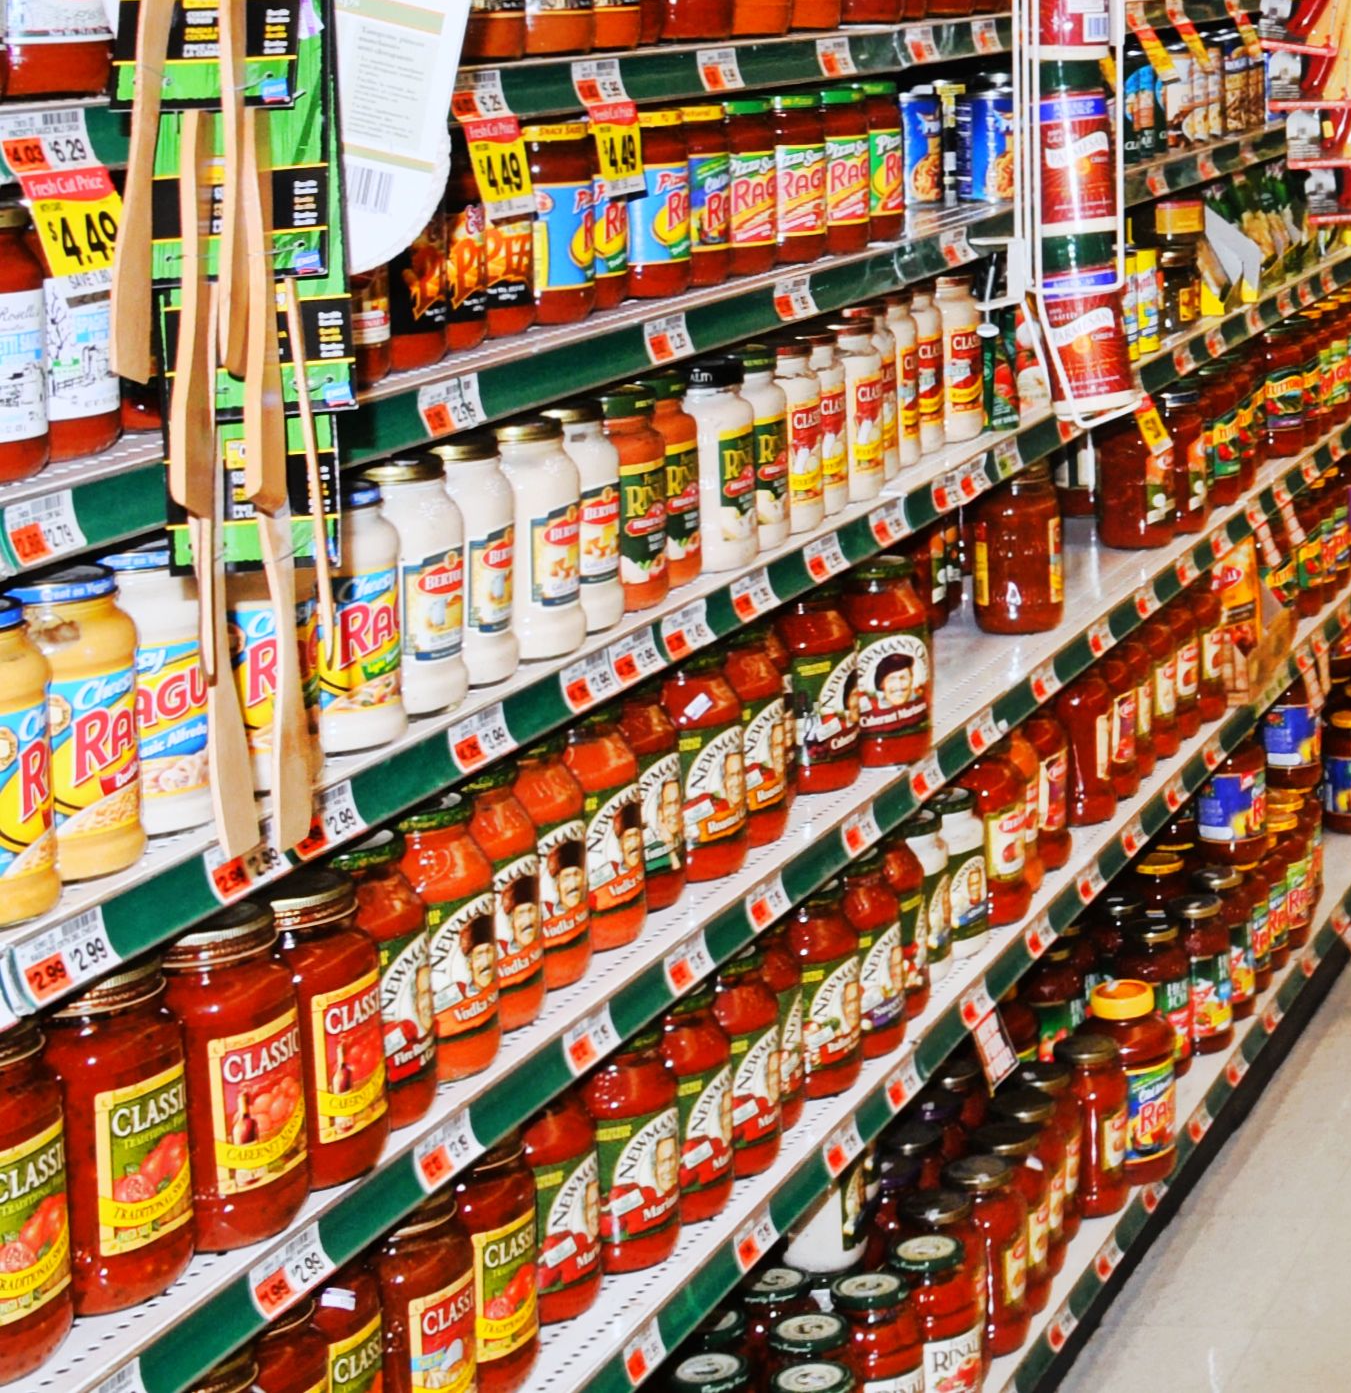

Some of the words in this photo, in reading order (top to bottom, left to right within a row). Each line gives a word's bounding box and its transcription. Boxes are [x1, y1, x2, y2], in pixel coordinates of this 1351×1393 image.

[603, 134, 637, 174] $4.49
[28, 178, 56, 197] Fresh
[55, 178, 76, 194] Cut
[76, 174, 104, 191] Price
[478, 152, 524, 194] $4.49
[68, 274, 94, 290] SAVE
[167, 722, 208, 749] Alfredo
[453, 998, 488, 1022] Vodka
